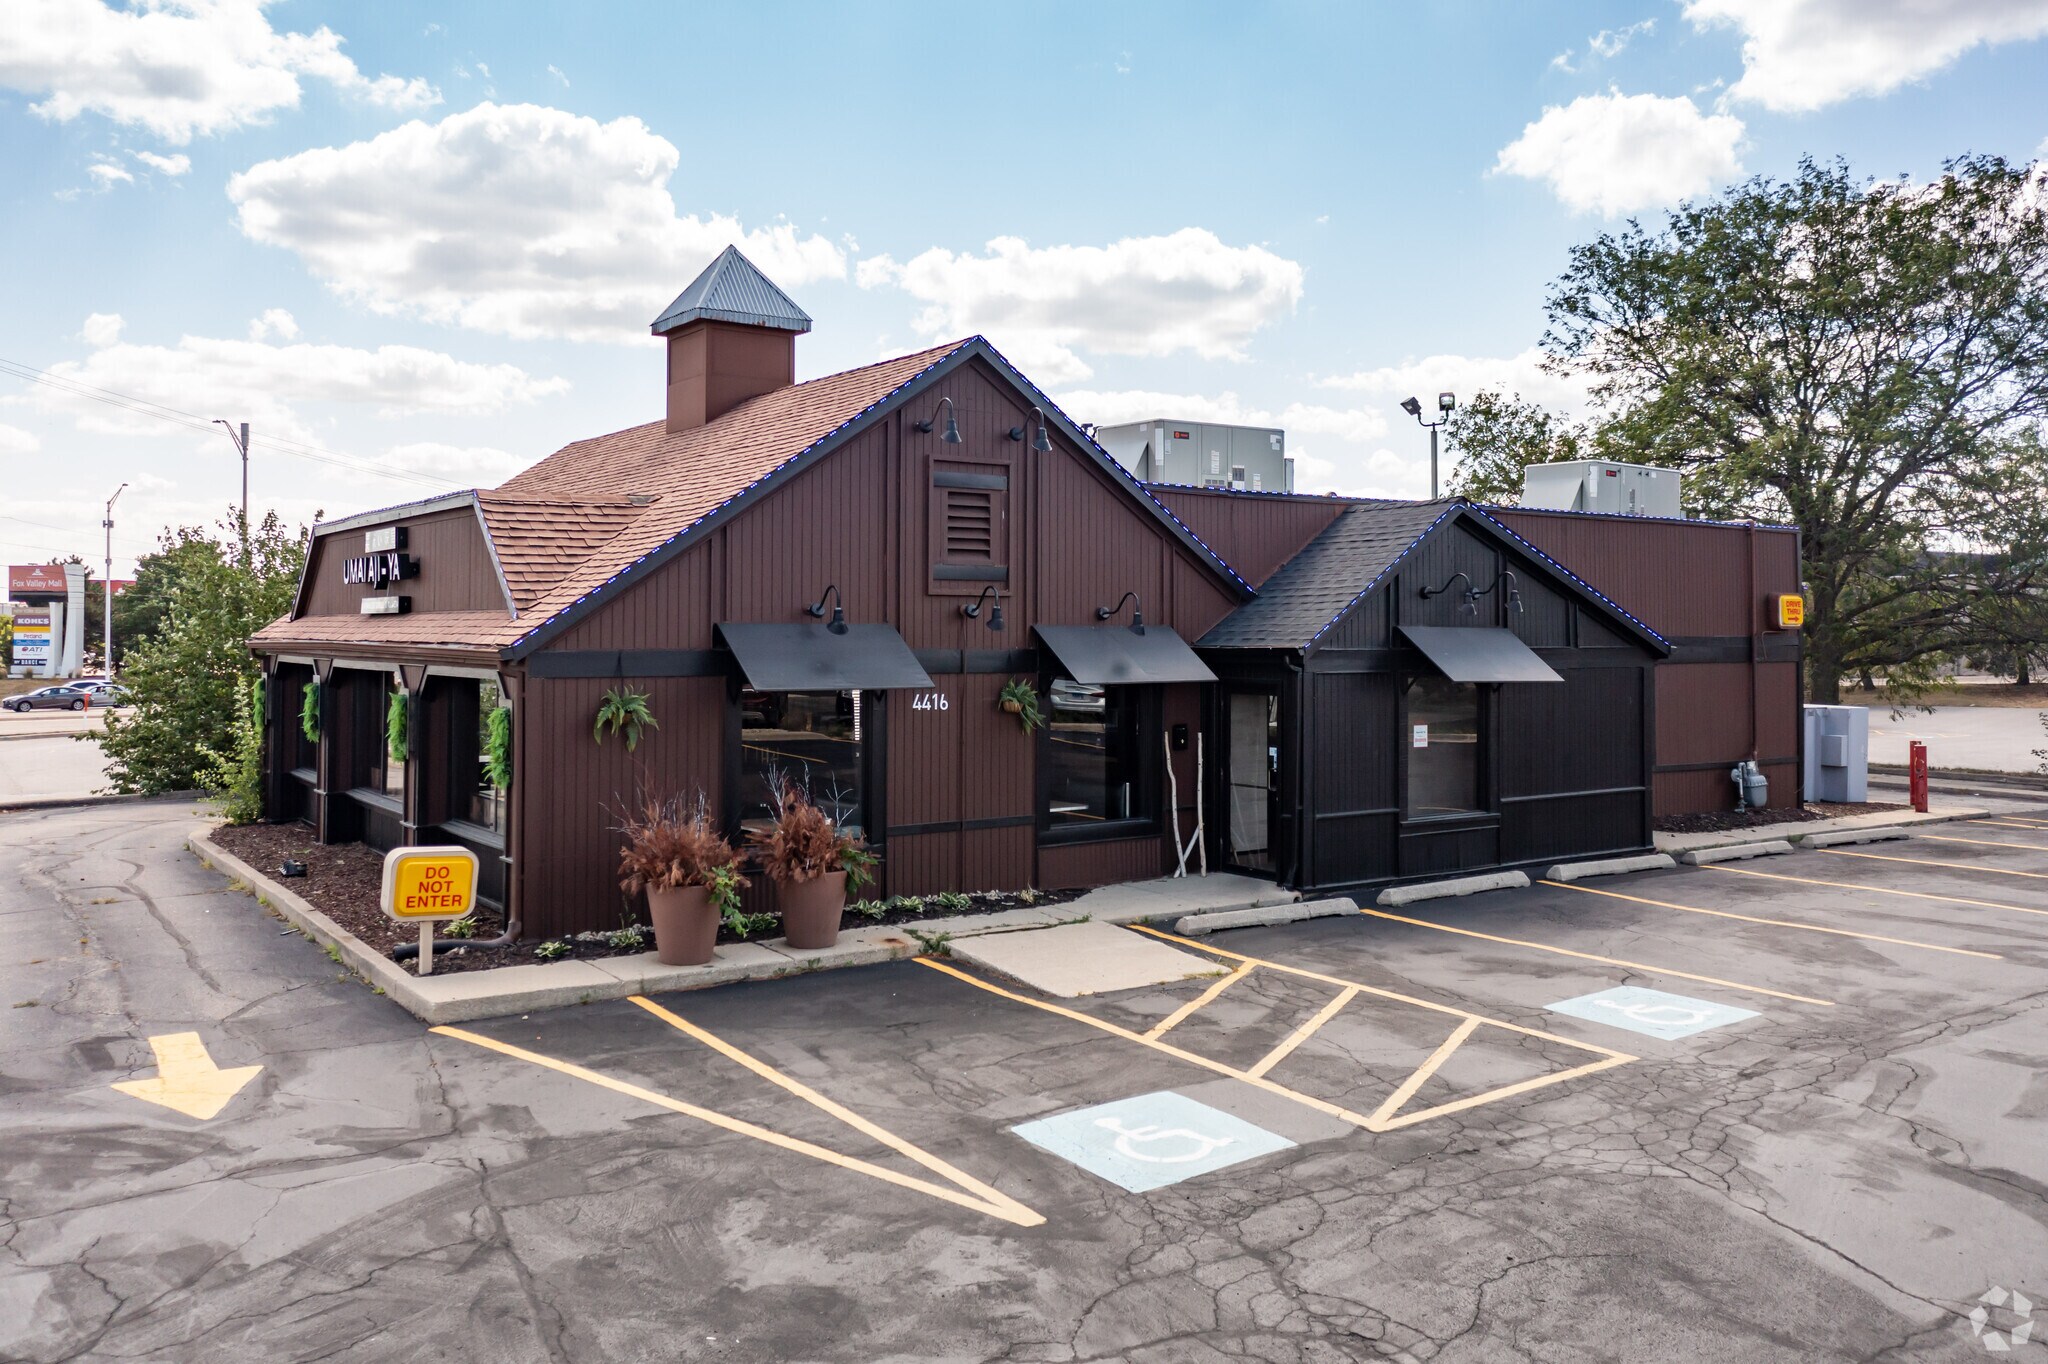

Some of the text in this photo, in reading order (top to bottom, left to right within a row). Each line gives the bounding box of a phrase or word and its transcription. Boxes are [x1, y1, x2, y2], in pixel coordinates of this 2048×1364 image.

[12, 579, 63, 589] Fox Valley Mall
[1785, 600, 1802, 608] DRIVE
[912, 693, 949, 711] 4416
[425, 866, 450, 879] DO
[418, 880, 454, 894] NOT
[405, 894, 463, 908] ENTER
